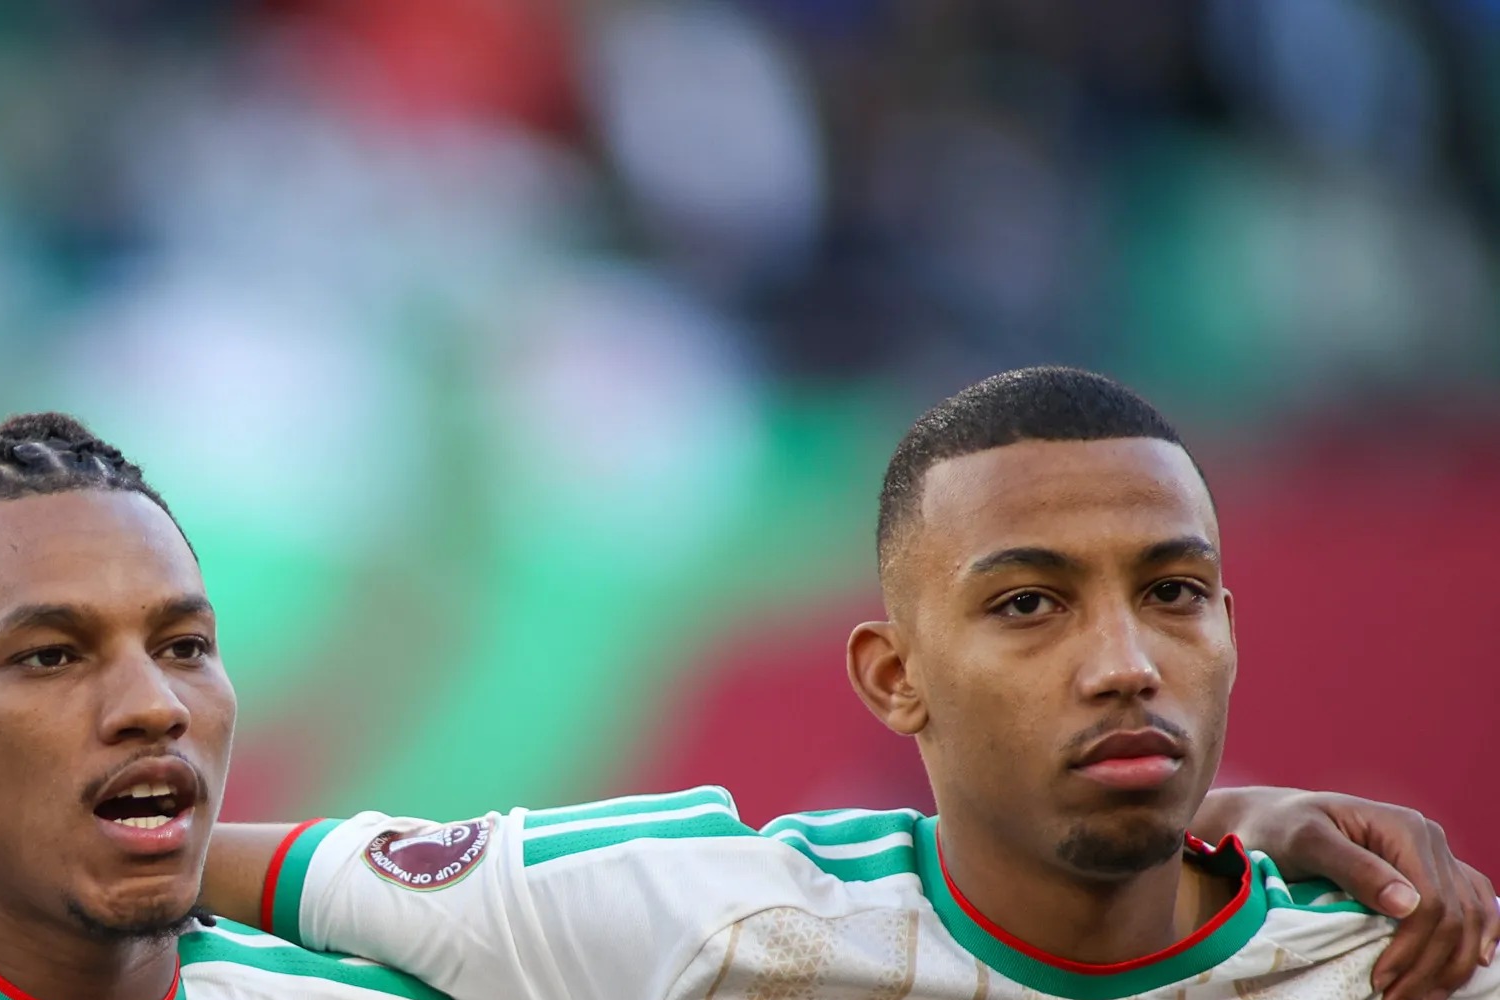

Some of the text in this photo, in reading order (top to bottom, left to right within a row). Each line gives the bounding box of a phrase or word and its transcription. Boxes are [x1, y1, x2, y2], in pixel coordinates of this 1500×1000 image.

[371, 830, 488, 884] AFRICA CUP OF NATIONS
